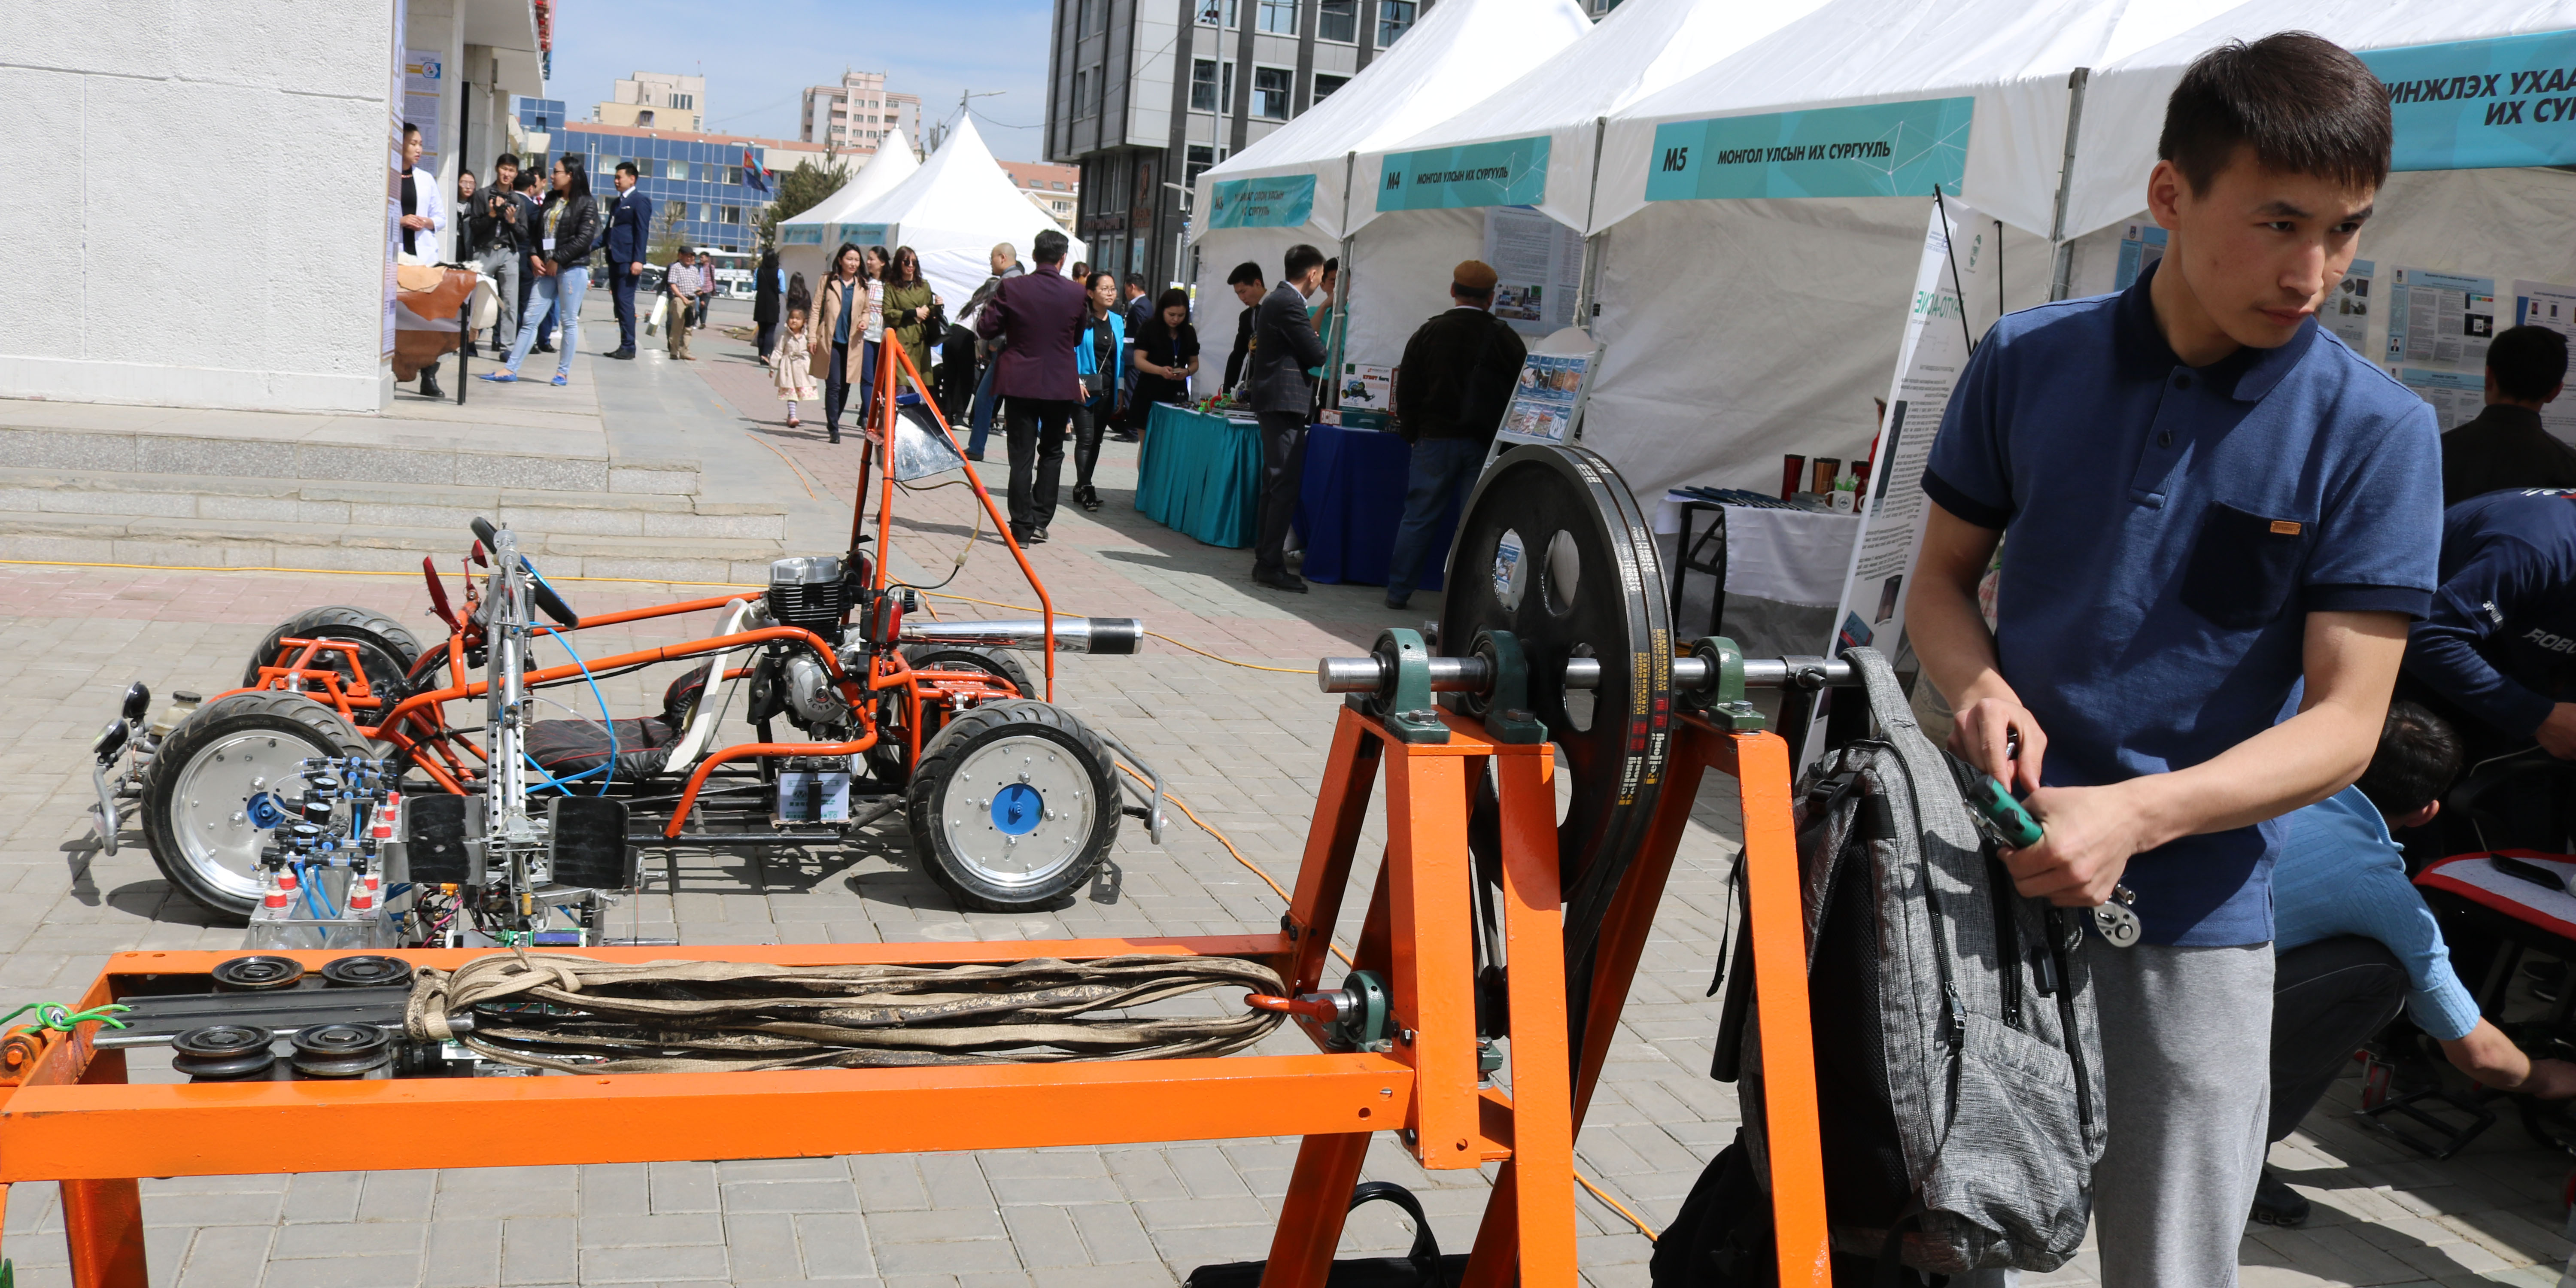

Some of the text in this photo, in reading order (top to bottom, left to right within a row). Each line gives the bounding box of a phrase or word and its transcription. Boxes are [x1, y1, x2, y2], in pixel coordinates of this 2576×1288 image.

[2385, 74, 2502, 104] ИНЖЛЭХ
[2484, 100, 2527, 126] ИХ
[1717, 141, 1891, 165] МОНГОЛ УЛСЫН ИХ СУРГУУЛЬ
[1417, 167, 1508, 185] МОНГОЛ УЛСЫН ИХ СУРГУУЛЬ
